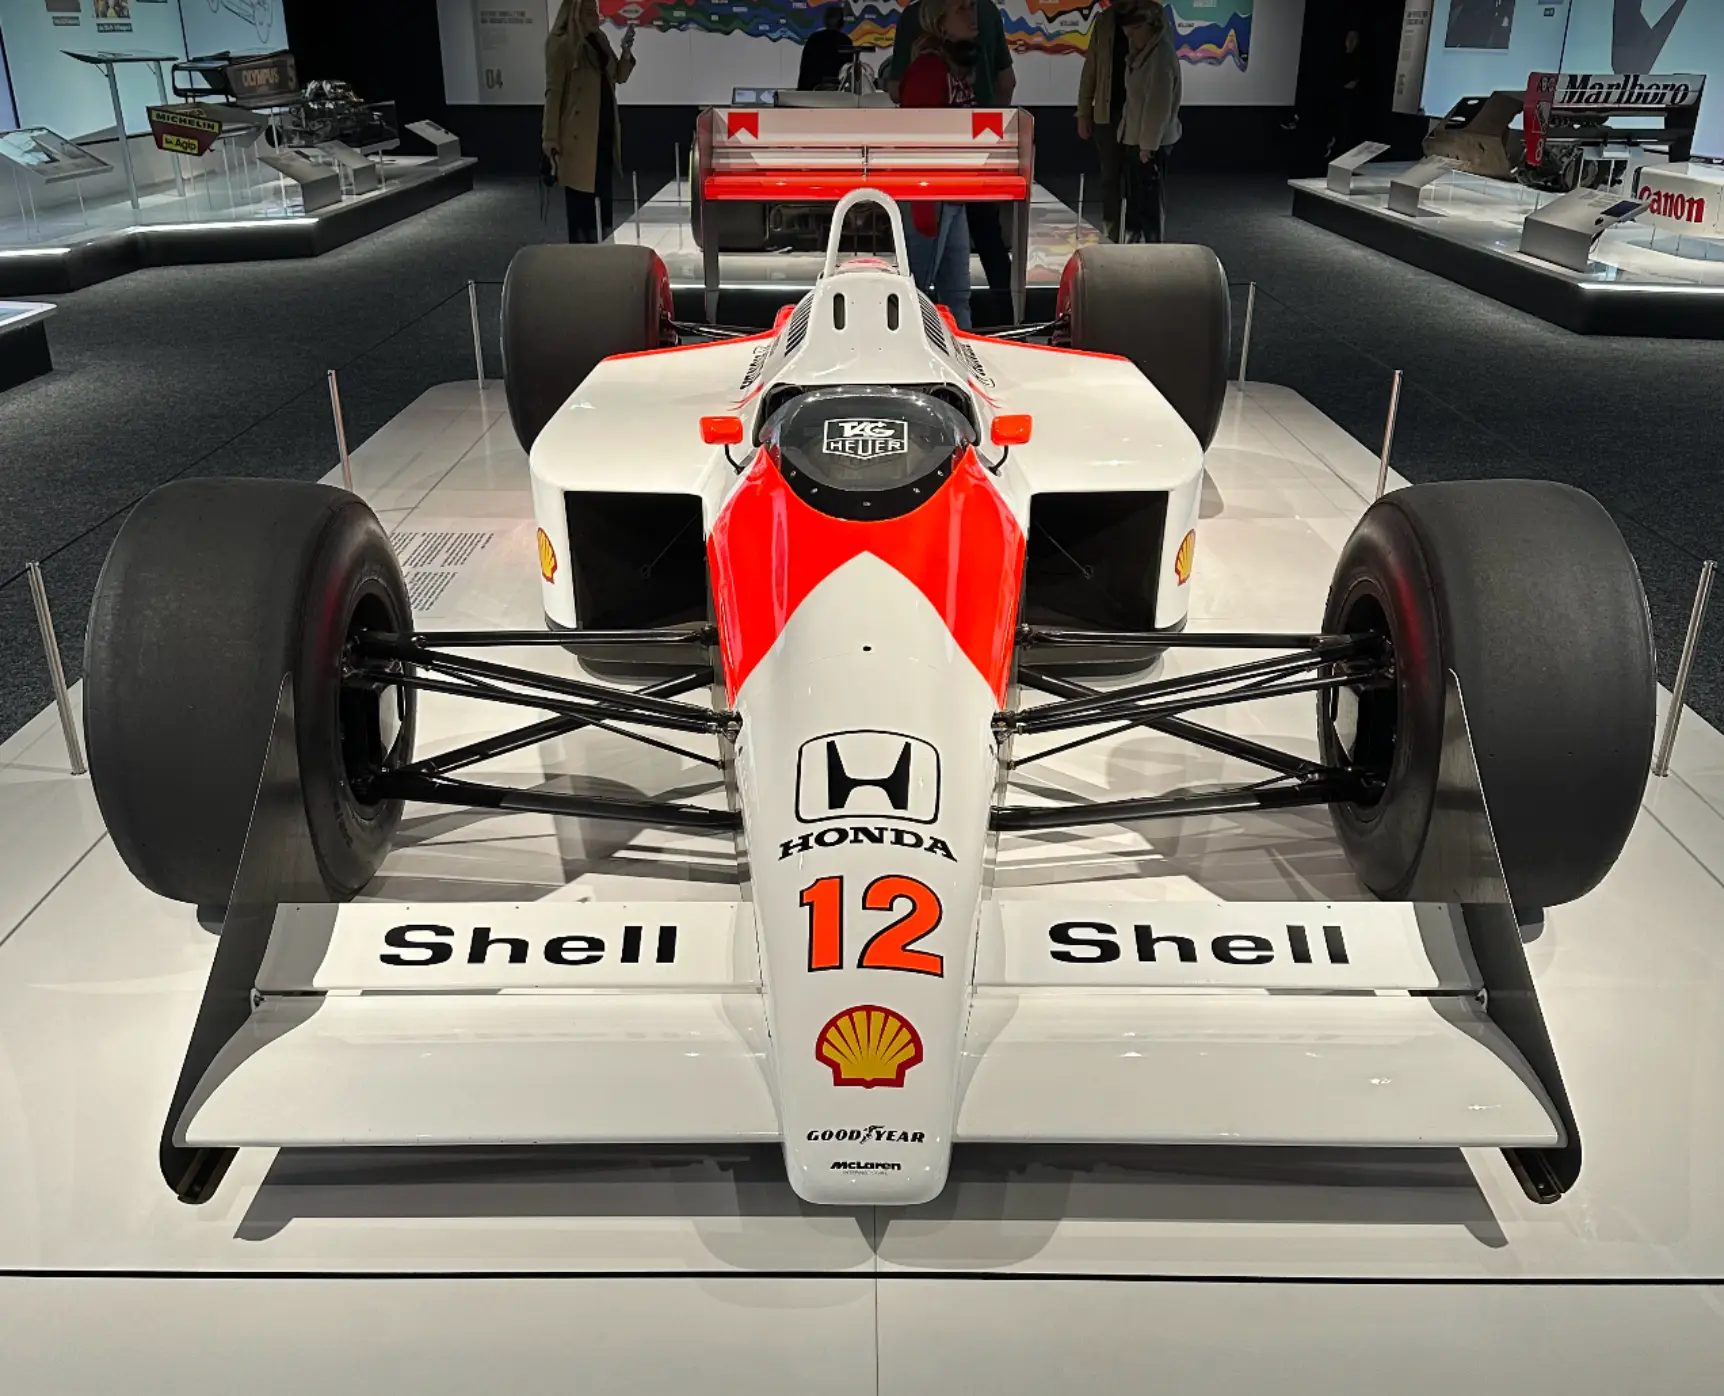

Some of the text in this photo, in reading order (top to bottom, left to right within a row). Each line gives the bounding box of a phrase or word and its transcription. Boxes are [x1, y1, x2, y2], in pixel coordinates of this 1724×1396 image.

[241, 66, 280, 88] OLYMPUS
[485, 68, 504, 89] 04
[1560, 74, 1690, 104] Marlboro
[155, 112, 215, 131] MICHELIN
[838, 421, 896, 438] TAG
[830, 439, 901, 456] HEUER
[778, 826, 958, 862] HONDA
[799, 874, 944, 978] 12
[379, 924, 677, 966] Shell
[1048, 921, 1350, 965] Shell
[829, 1161, 901, 1171] McLaren
